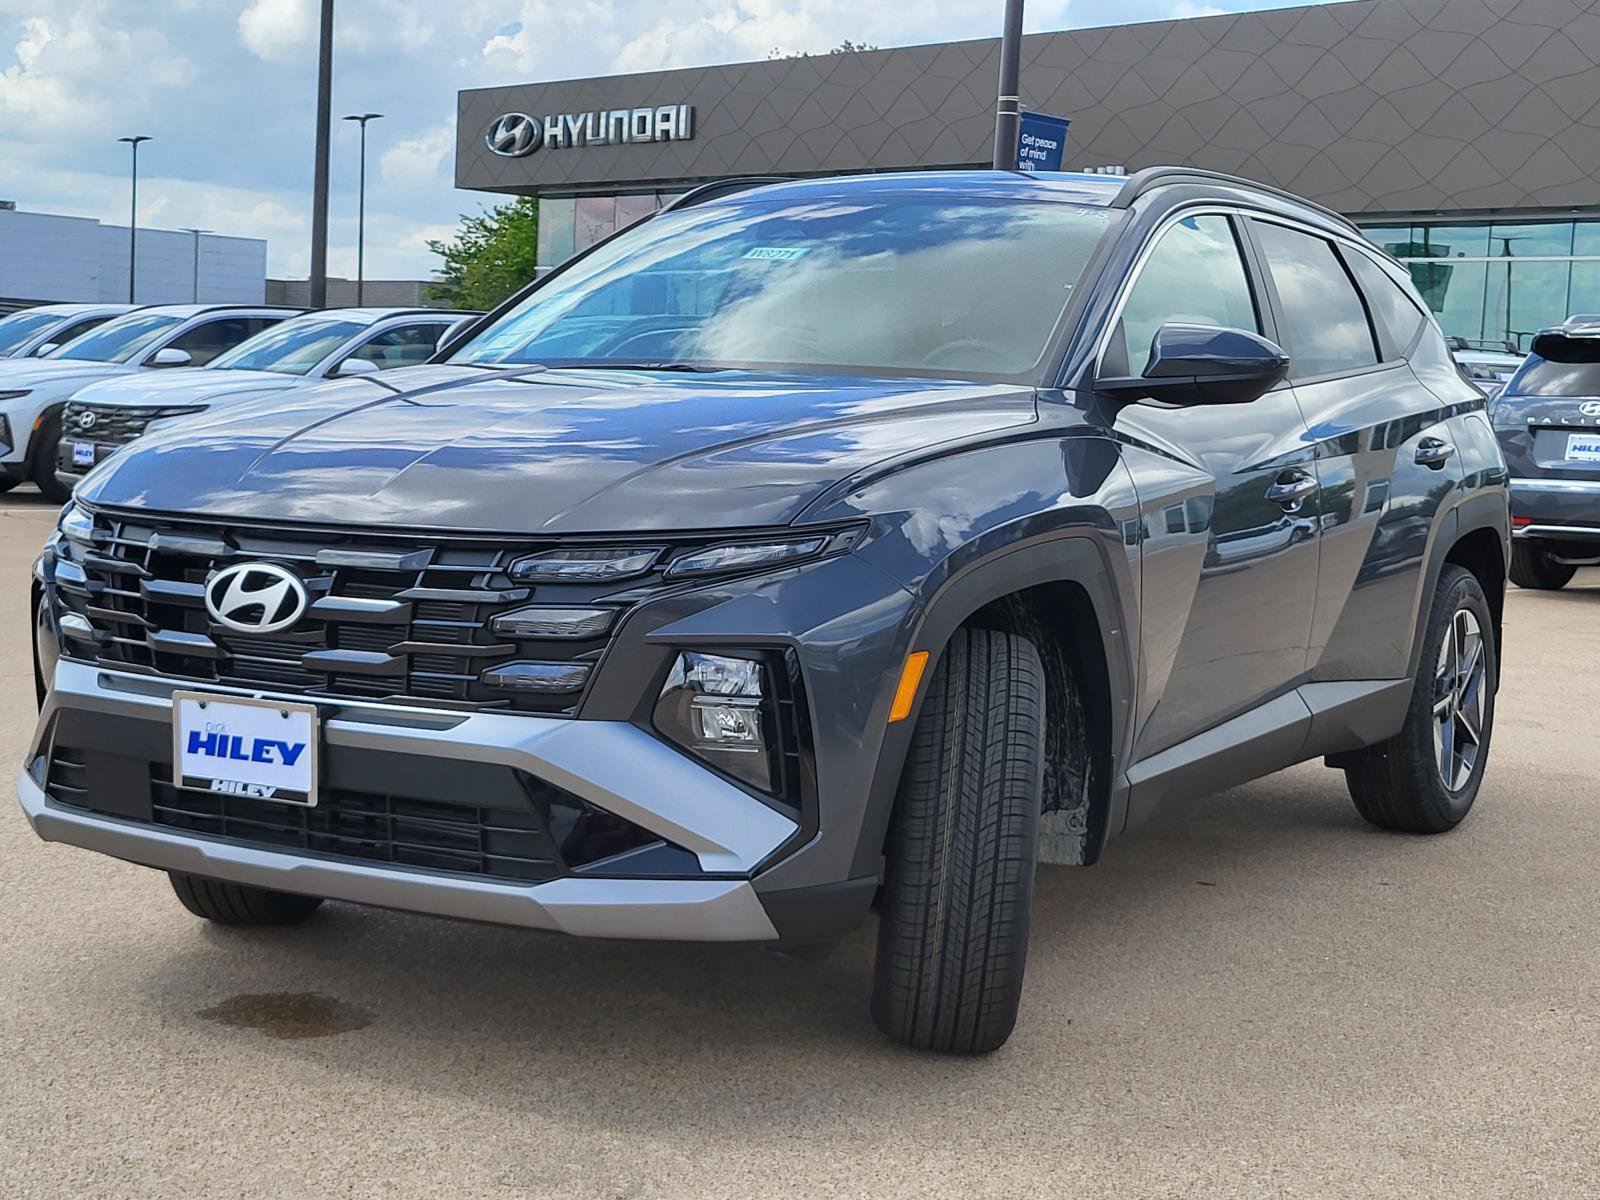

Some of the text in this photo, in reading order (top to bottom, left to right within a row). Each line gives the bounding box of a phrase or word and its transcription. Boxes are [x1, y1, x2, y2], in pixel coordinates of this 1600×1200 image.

[543, 105, 692, 148] HYUNDAI
[1022, 134, 1056, 149] Get peace
[1020, 147, 1046, 160] of mind
[1018, 159, 1034, 171] with
[187, 730, 307, 766] HILEY
[211, 779, 277, 798] HILEY
